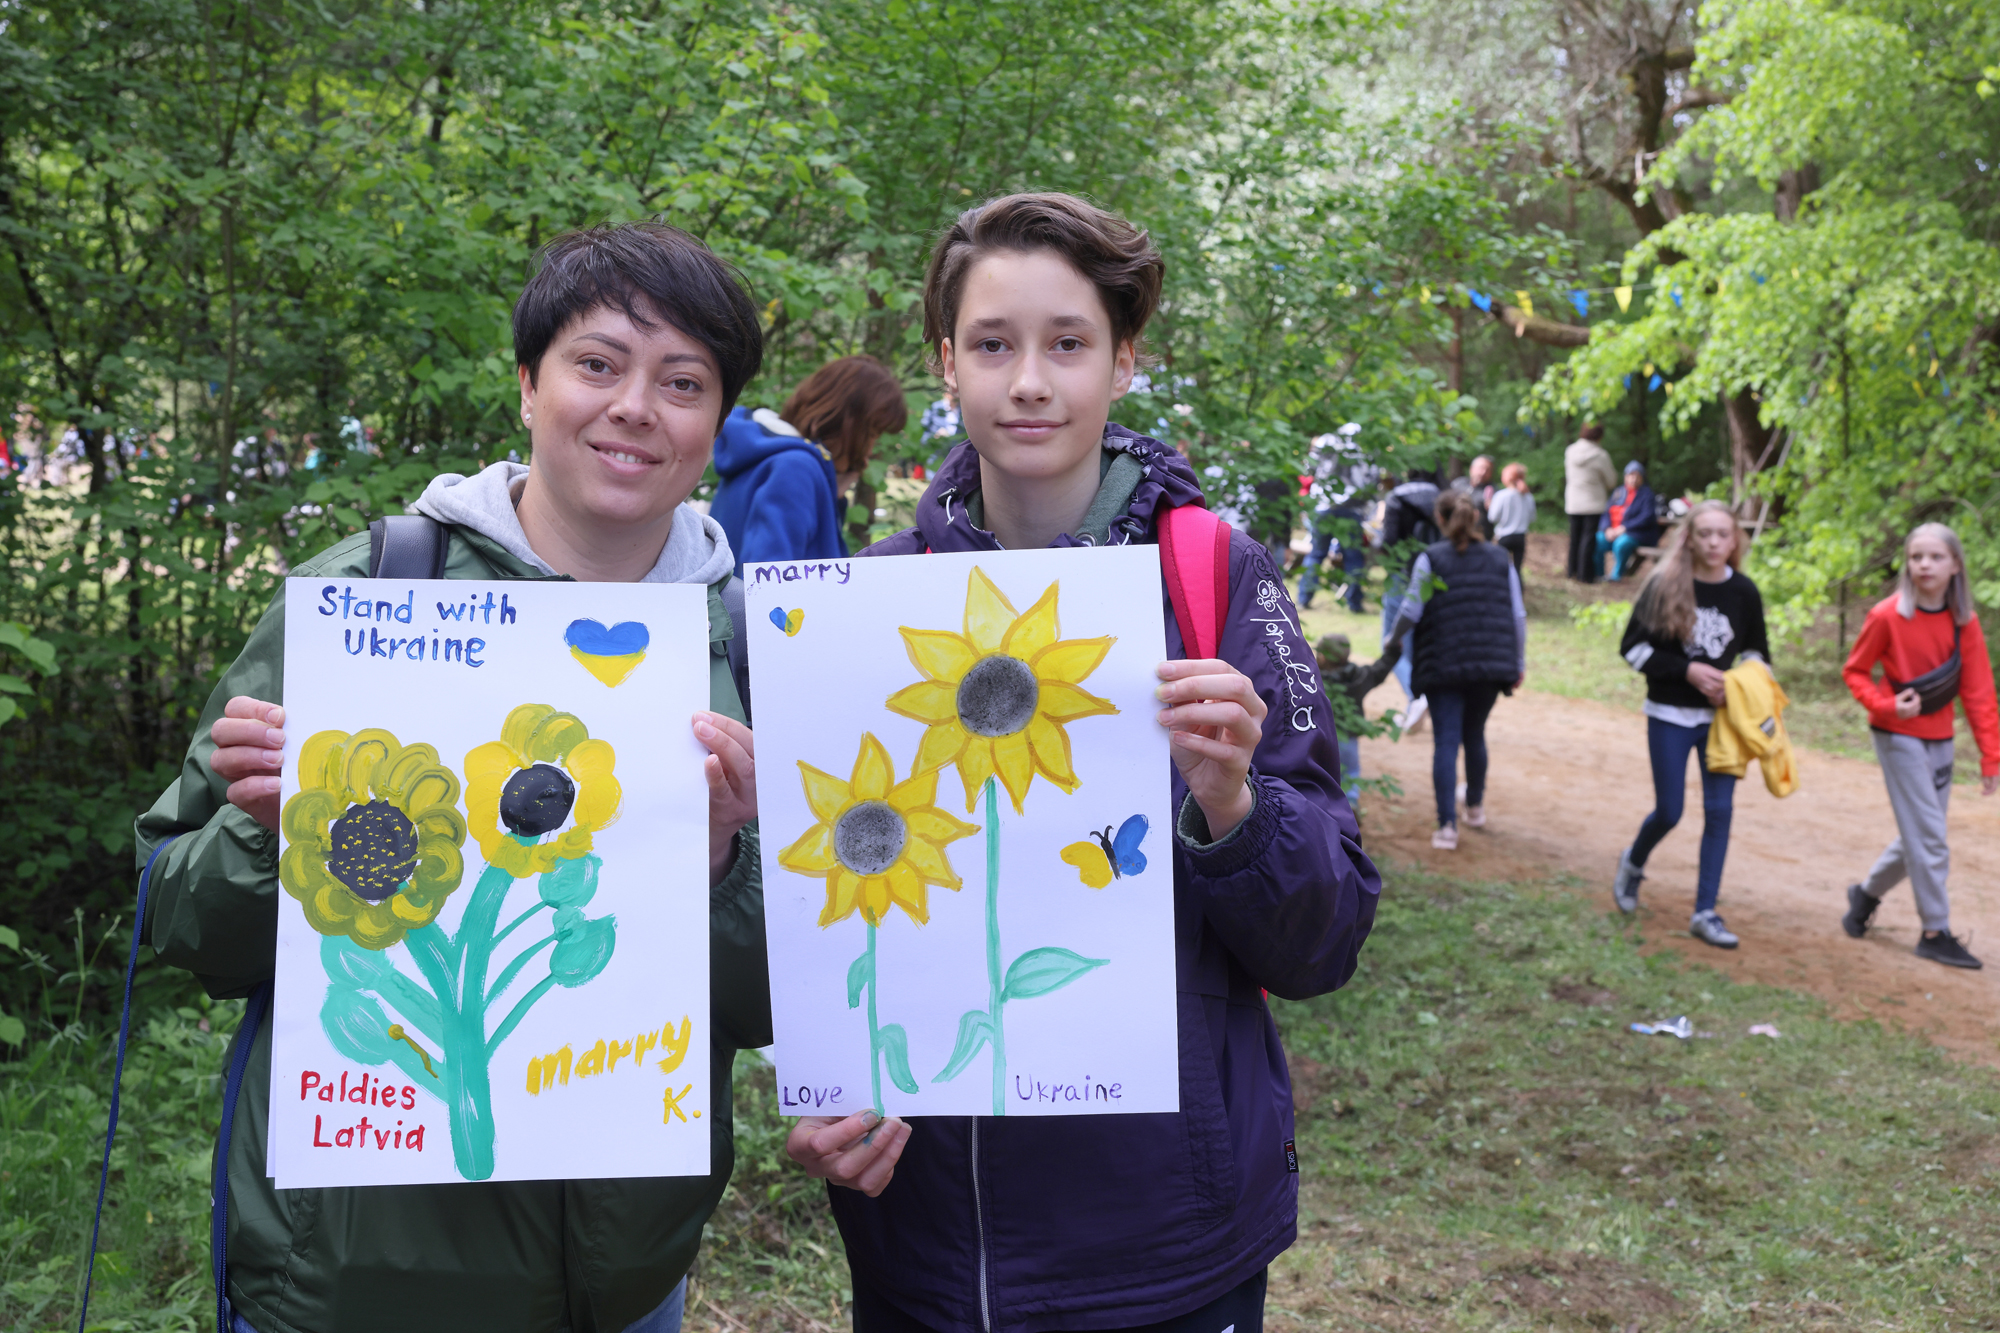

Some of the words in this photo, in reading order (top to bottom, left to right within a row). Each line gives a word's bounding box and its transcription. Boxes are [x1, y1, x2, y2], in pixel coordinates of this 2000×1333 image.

[318, 585, 413, 624] Stand
[436, 592, 517, 625] with
[344, 627, 487, 668] Ukraine
[300, 1070, 416, 1111] Paldies
[663, 1084, 702, 1124] K.
[1015, 1074, 1122, 1103] Ukraine
[313, 1115, 425, 1152] Latvia
